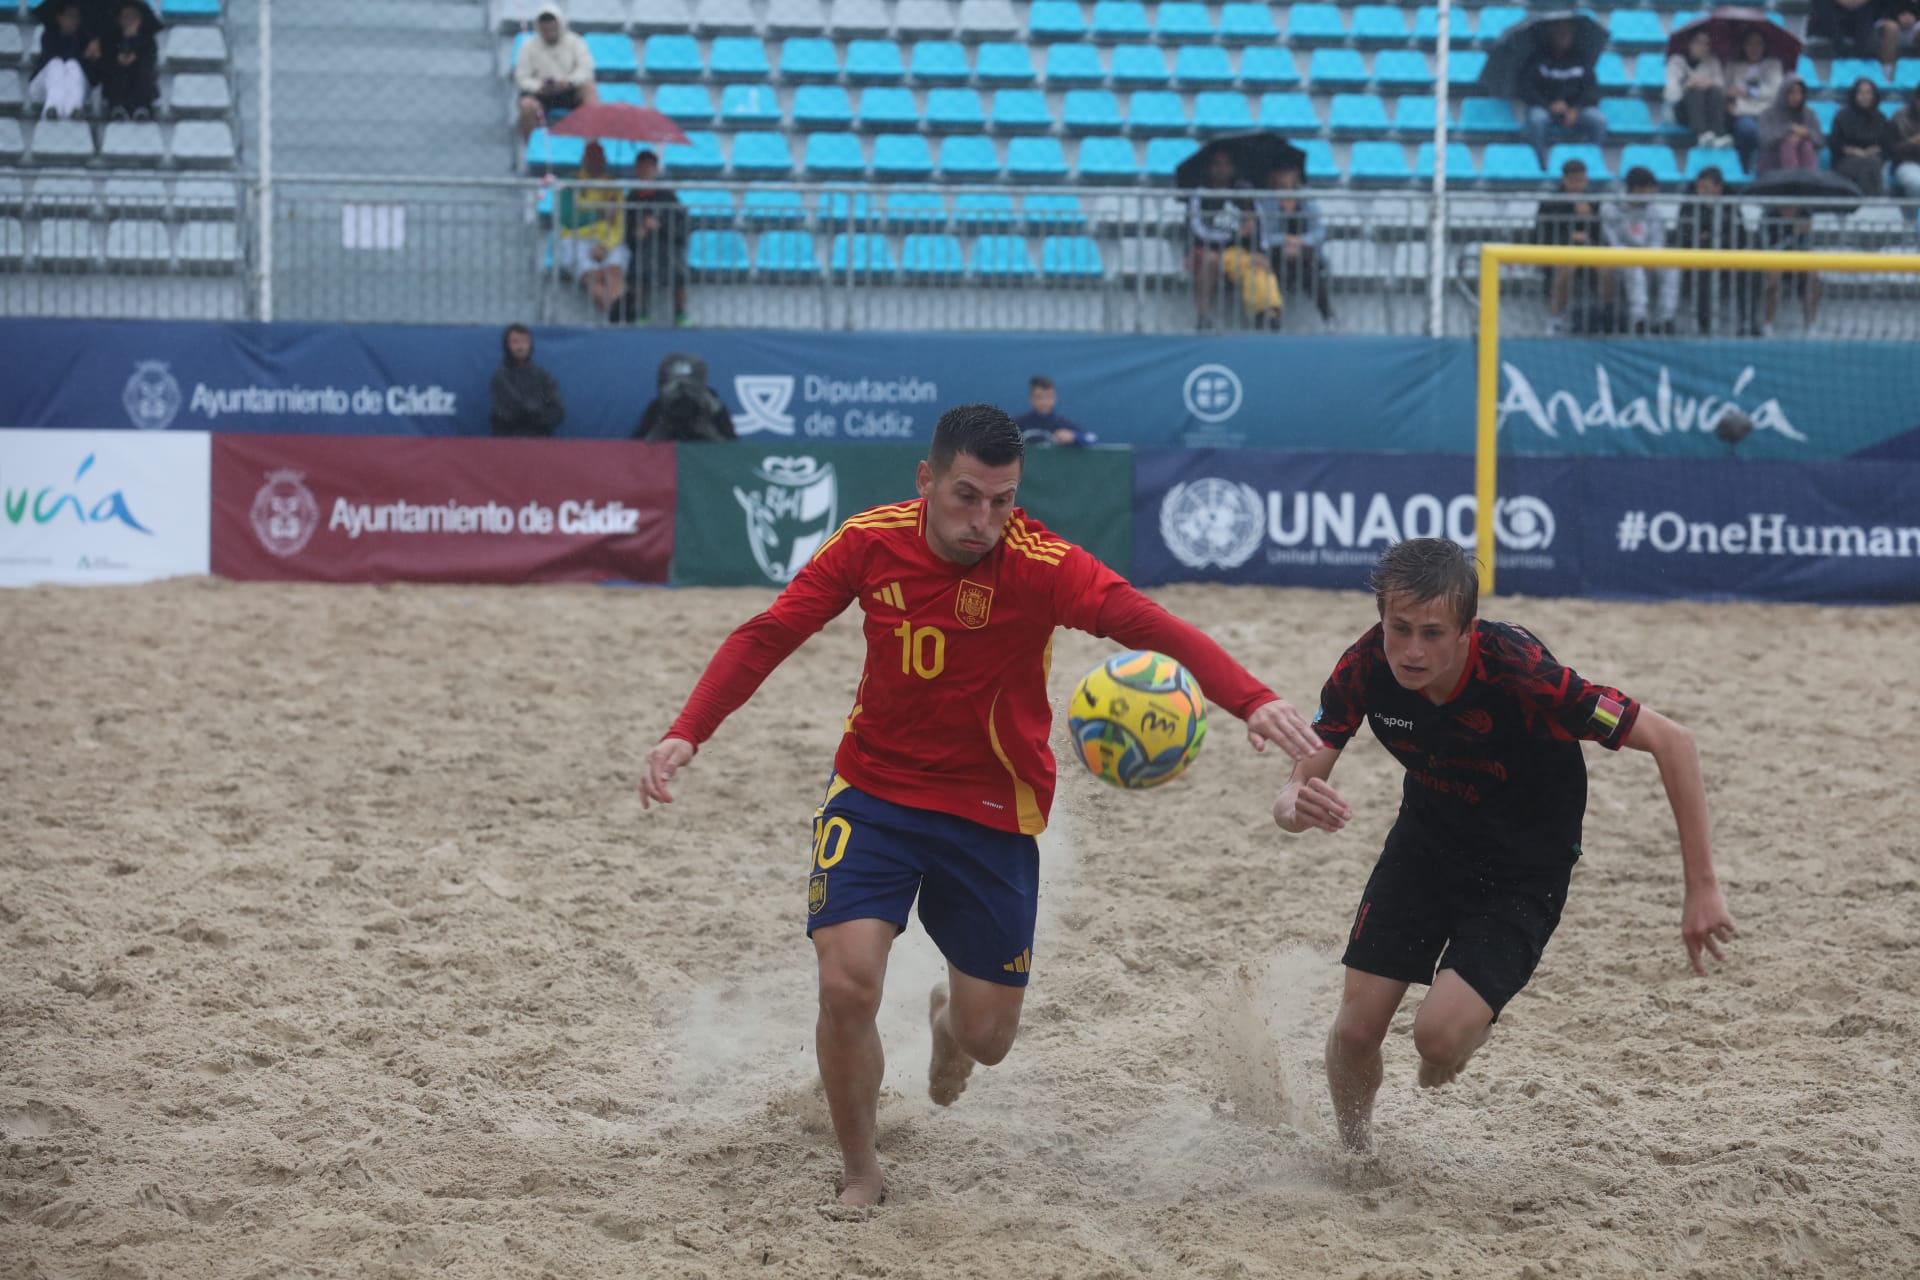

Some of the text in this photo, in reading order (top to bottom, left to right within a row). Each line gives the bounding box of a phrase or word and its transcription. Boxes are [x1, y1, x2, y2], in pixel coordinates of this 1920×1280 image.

[190, 382, 456, 419] Ayuntamiento de Cádiz
[804, 374, 937, 405] Diputación
[804, 408, 914, 438] de Cádiz
[329, 497, 640, 539] Ayuntamiento de Cádiz
[894, 620, 945, 680] 10
[809, 815, 853, 873] 10
